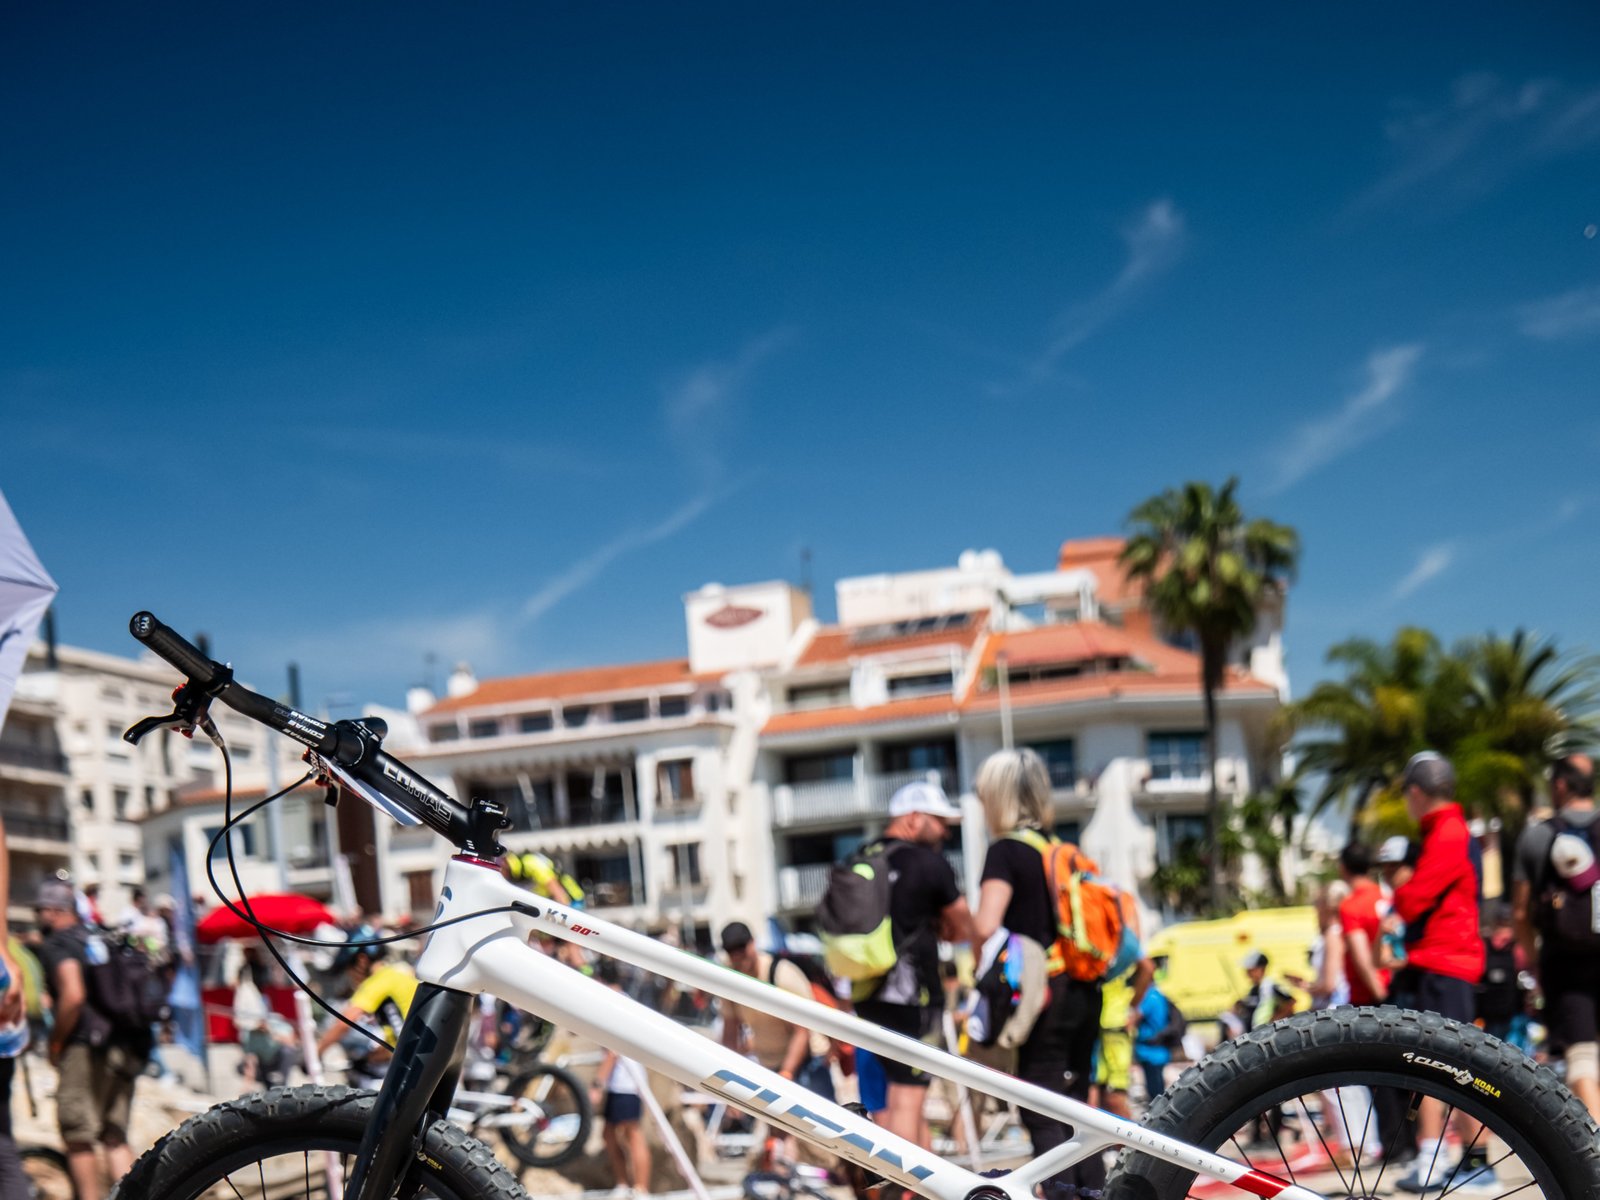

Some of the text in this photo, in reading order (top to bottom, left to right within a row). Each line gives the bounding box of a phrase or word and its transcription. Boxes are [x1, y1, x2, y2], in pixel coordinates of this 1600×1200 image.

[287, 719, 325, 740] COMAS
[290, 710, 328, 730] COMAS
[383, 761, 453, 821] COMAS
[544, 908, 568, 927] K1
[1413, 1055, 1464, 1078] CLEAN
[1473, 1077, 1502, 1098] KOALA
[1115, 1127, 1180, 1157] TRIALS
